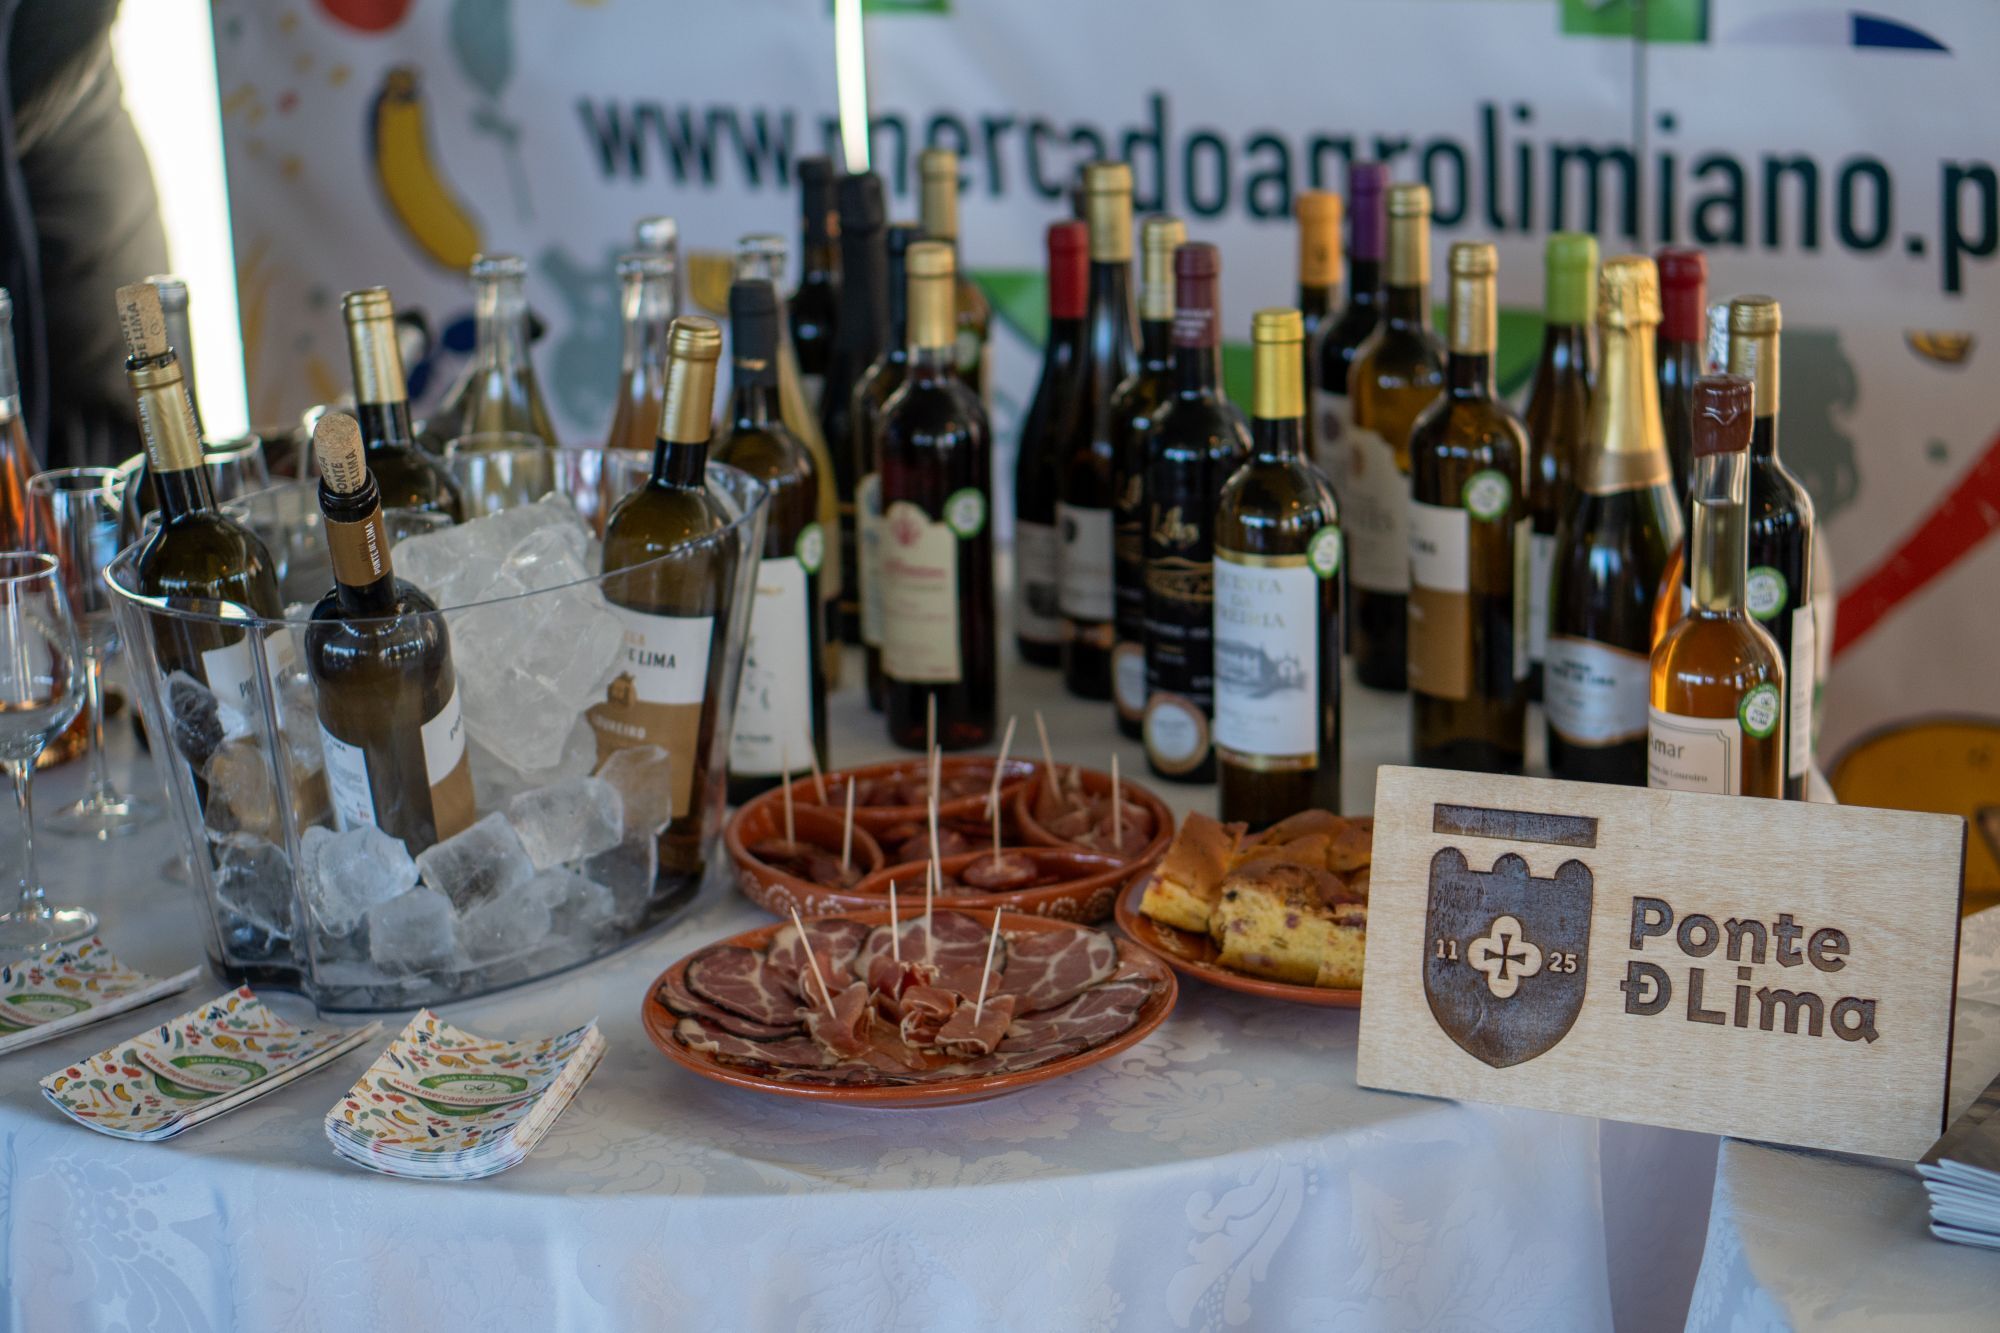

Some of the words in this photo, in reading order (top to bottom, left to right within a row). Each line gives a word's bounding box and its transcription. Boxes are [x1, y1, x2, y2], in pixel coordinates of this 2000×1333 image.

[127, 302, 145, 340] LIMA
[344, 449, 361, 477] LIMA
[364, 521, 377, 544] LIMA
[369, 549, 382, 576] PONTE
[638, 650, 676, 669] LIMA
[1630, 896, 1851, 973] Ponte
[1436, 939, 1459, 960] 11
[1549, 952, 1577, 974] 25
